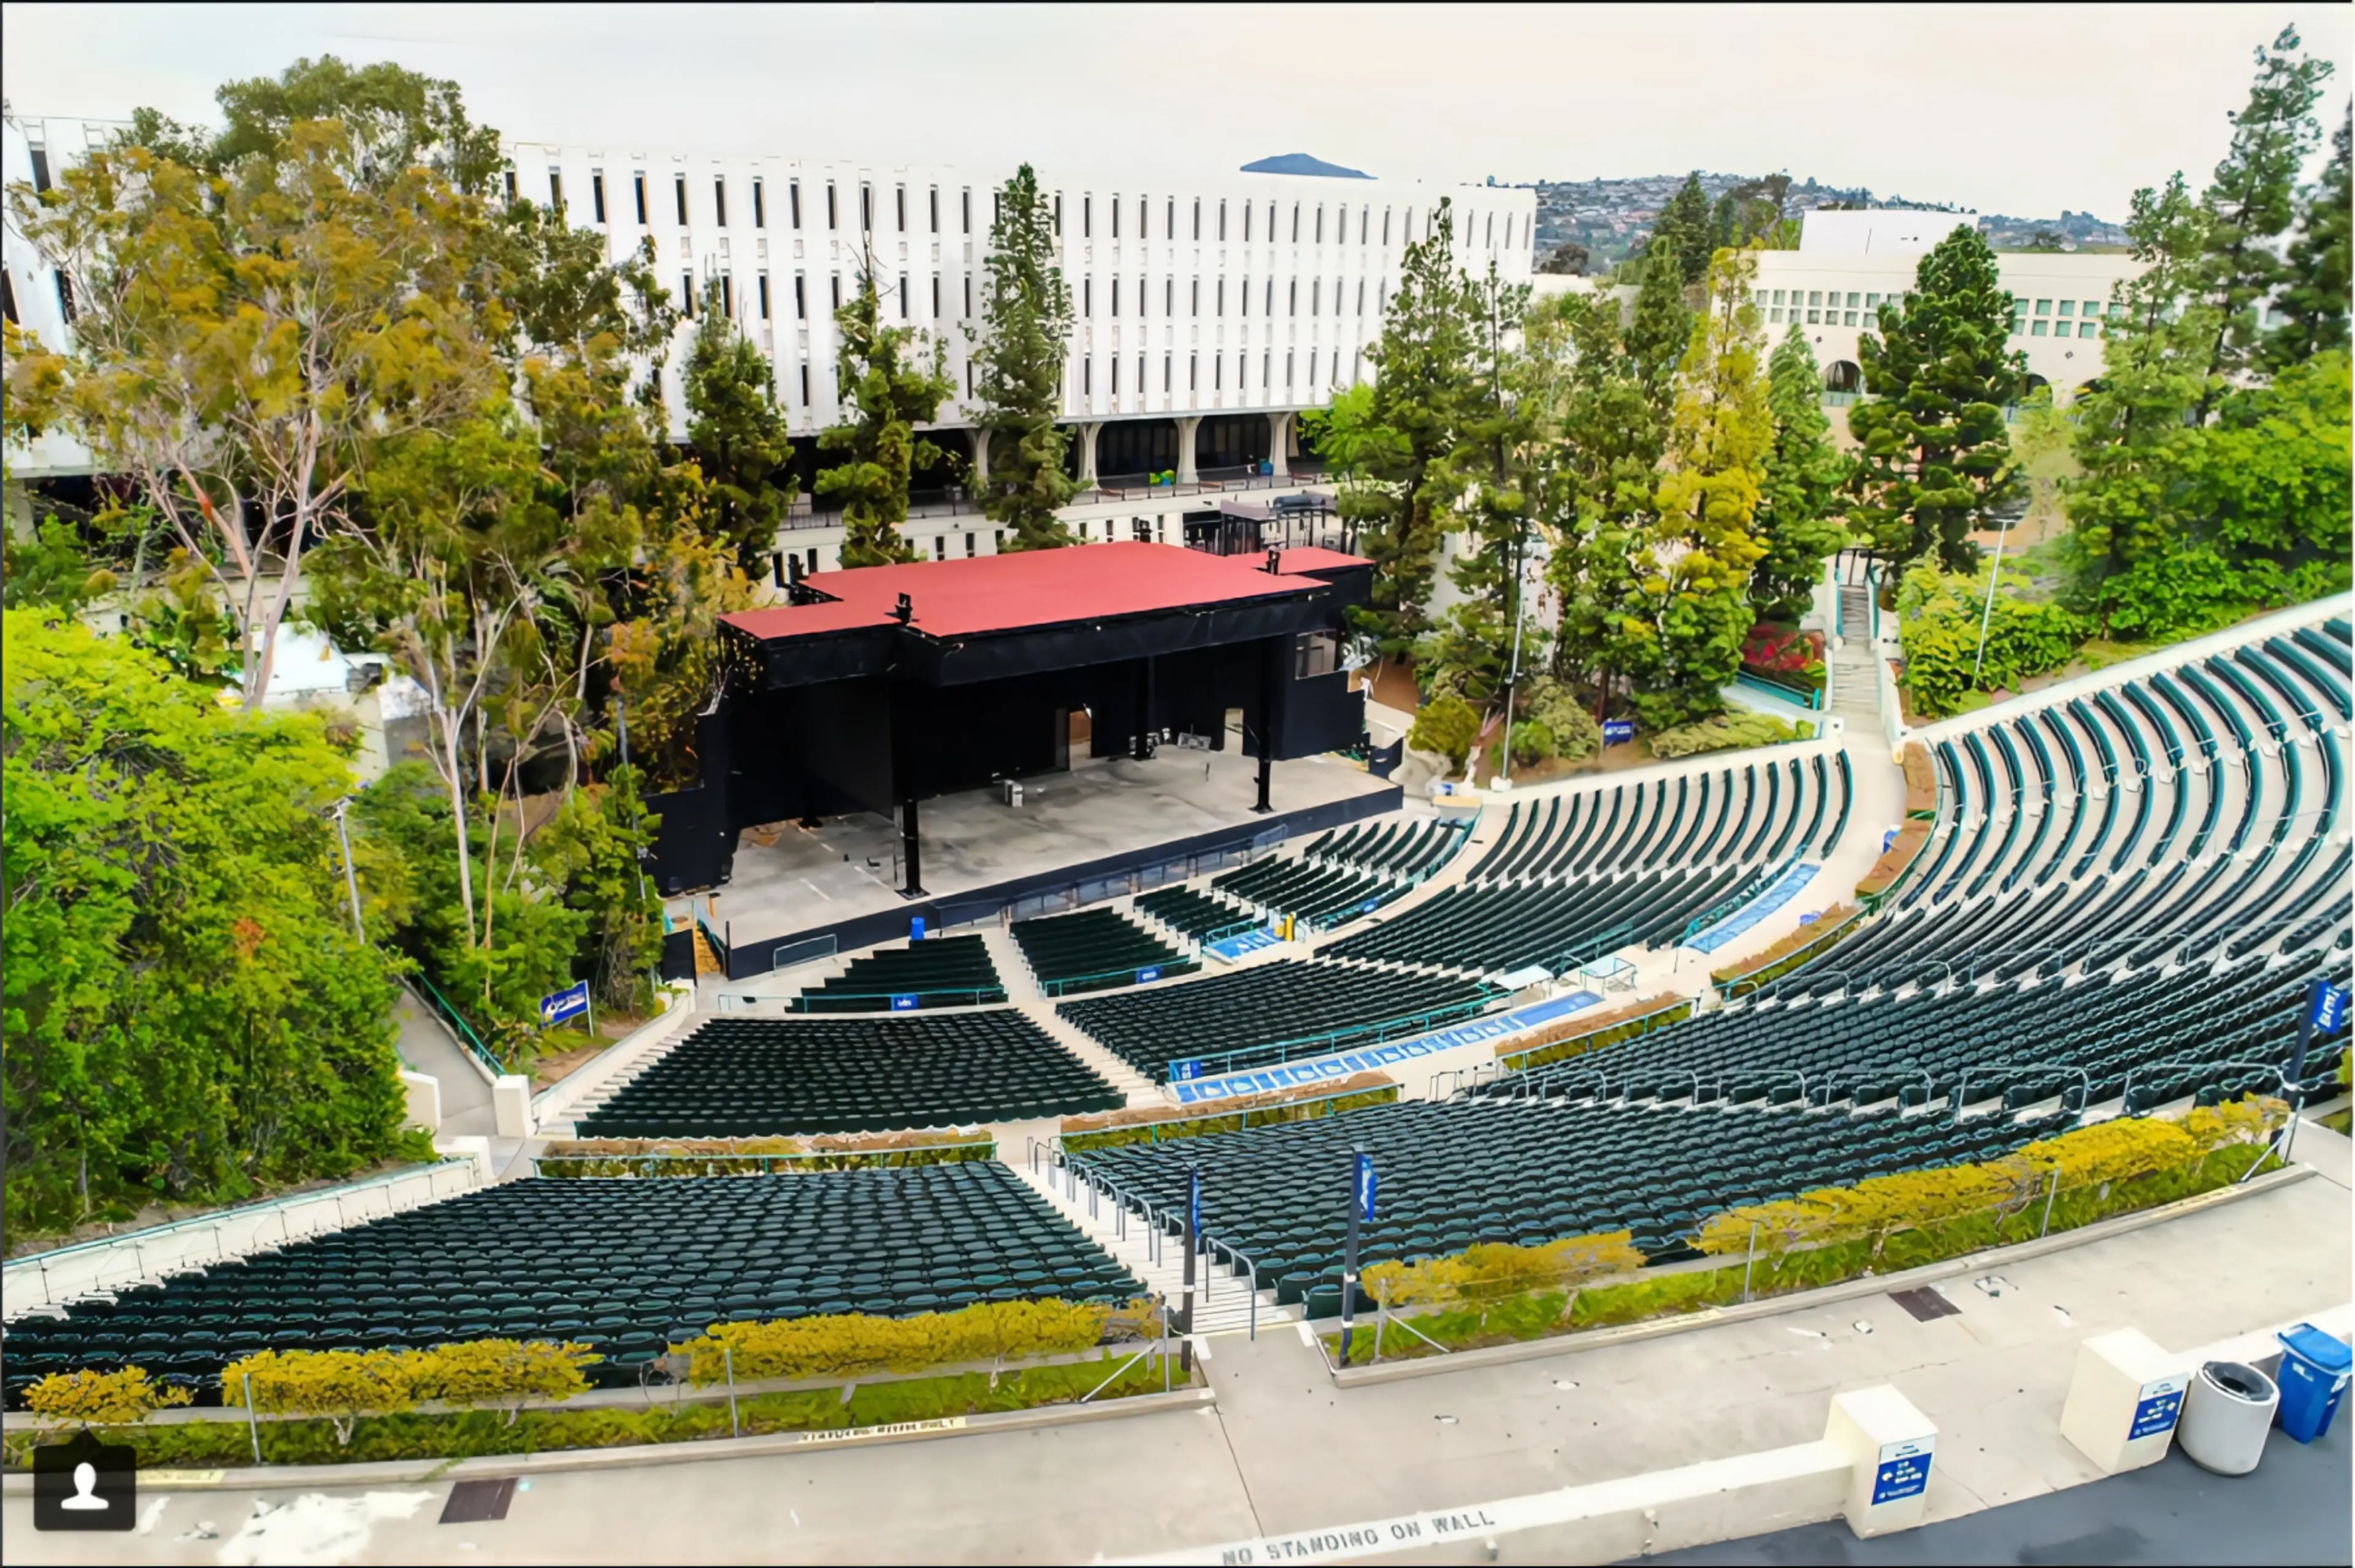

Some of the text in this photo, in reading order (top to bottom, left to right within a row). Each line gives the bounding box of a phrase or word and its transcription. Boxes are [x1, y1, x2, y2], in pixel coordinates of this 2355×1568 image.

[1222, 1511, 1495, 1566] NO STANDING ON WALL
